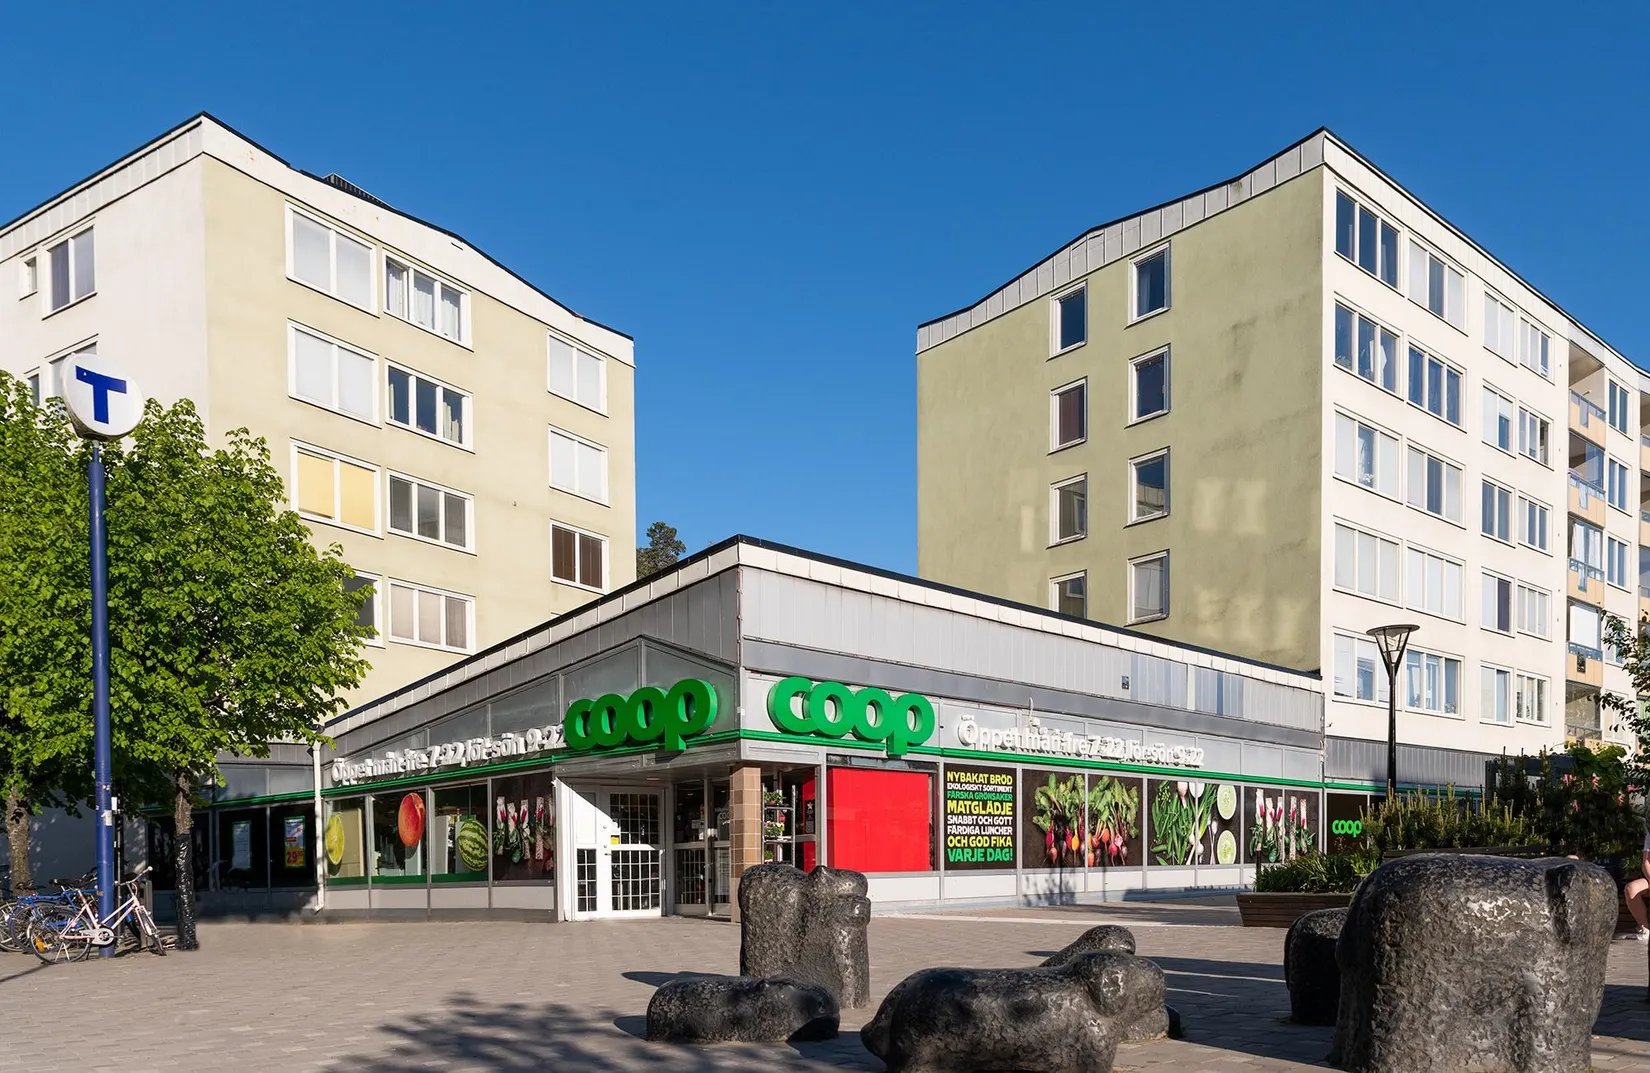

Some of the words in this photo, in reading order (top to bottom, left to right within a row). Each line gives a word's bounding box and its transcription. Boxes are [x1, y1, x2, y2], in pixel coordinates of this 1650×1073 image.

[75, 365, 127, 424] T
[564, 678, 717, 752] coop
[767, 676, 935, 757] coop
[957, 714, 1021, 752] Öppet
[1172, 745, 1204, 767] 9-22
[331, 757, 373, 785] Öppet
[947, 771, 988, 784] NYBAKAT
[989, 774, 1013, 785] BRÖD
[947, 783, 982, 791] EKOLOGISKT
[982, 785, 1013, 793] SORTIMENT
[947, 790, 974, 799] FÄRSKA
[974, 792, 1013, 801] GRÖNSAKER
[947, 800, 1013, 815] MATGLÄDJE
[947, 815, 977, 824] SNABBT
[977, 816, 993, 825] OCH
[993, 816, 1013, 825] GOTT
[947, 825, 980, 835] FÄRDIGA
[981, 826, 1013, 835] LUNCHER
[1332, 819, 1363, 838] coop
[947, 835, 968, 847] OCH
[969, 835, 990, 848] GOD
[991, 836, 1013, 847] FIKA
[947, 848, 985, 862] VARJE
[986, 848, 1013, 862] DAG!
